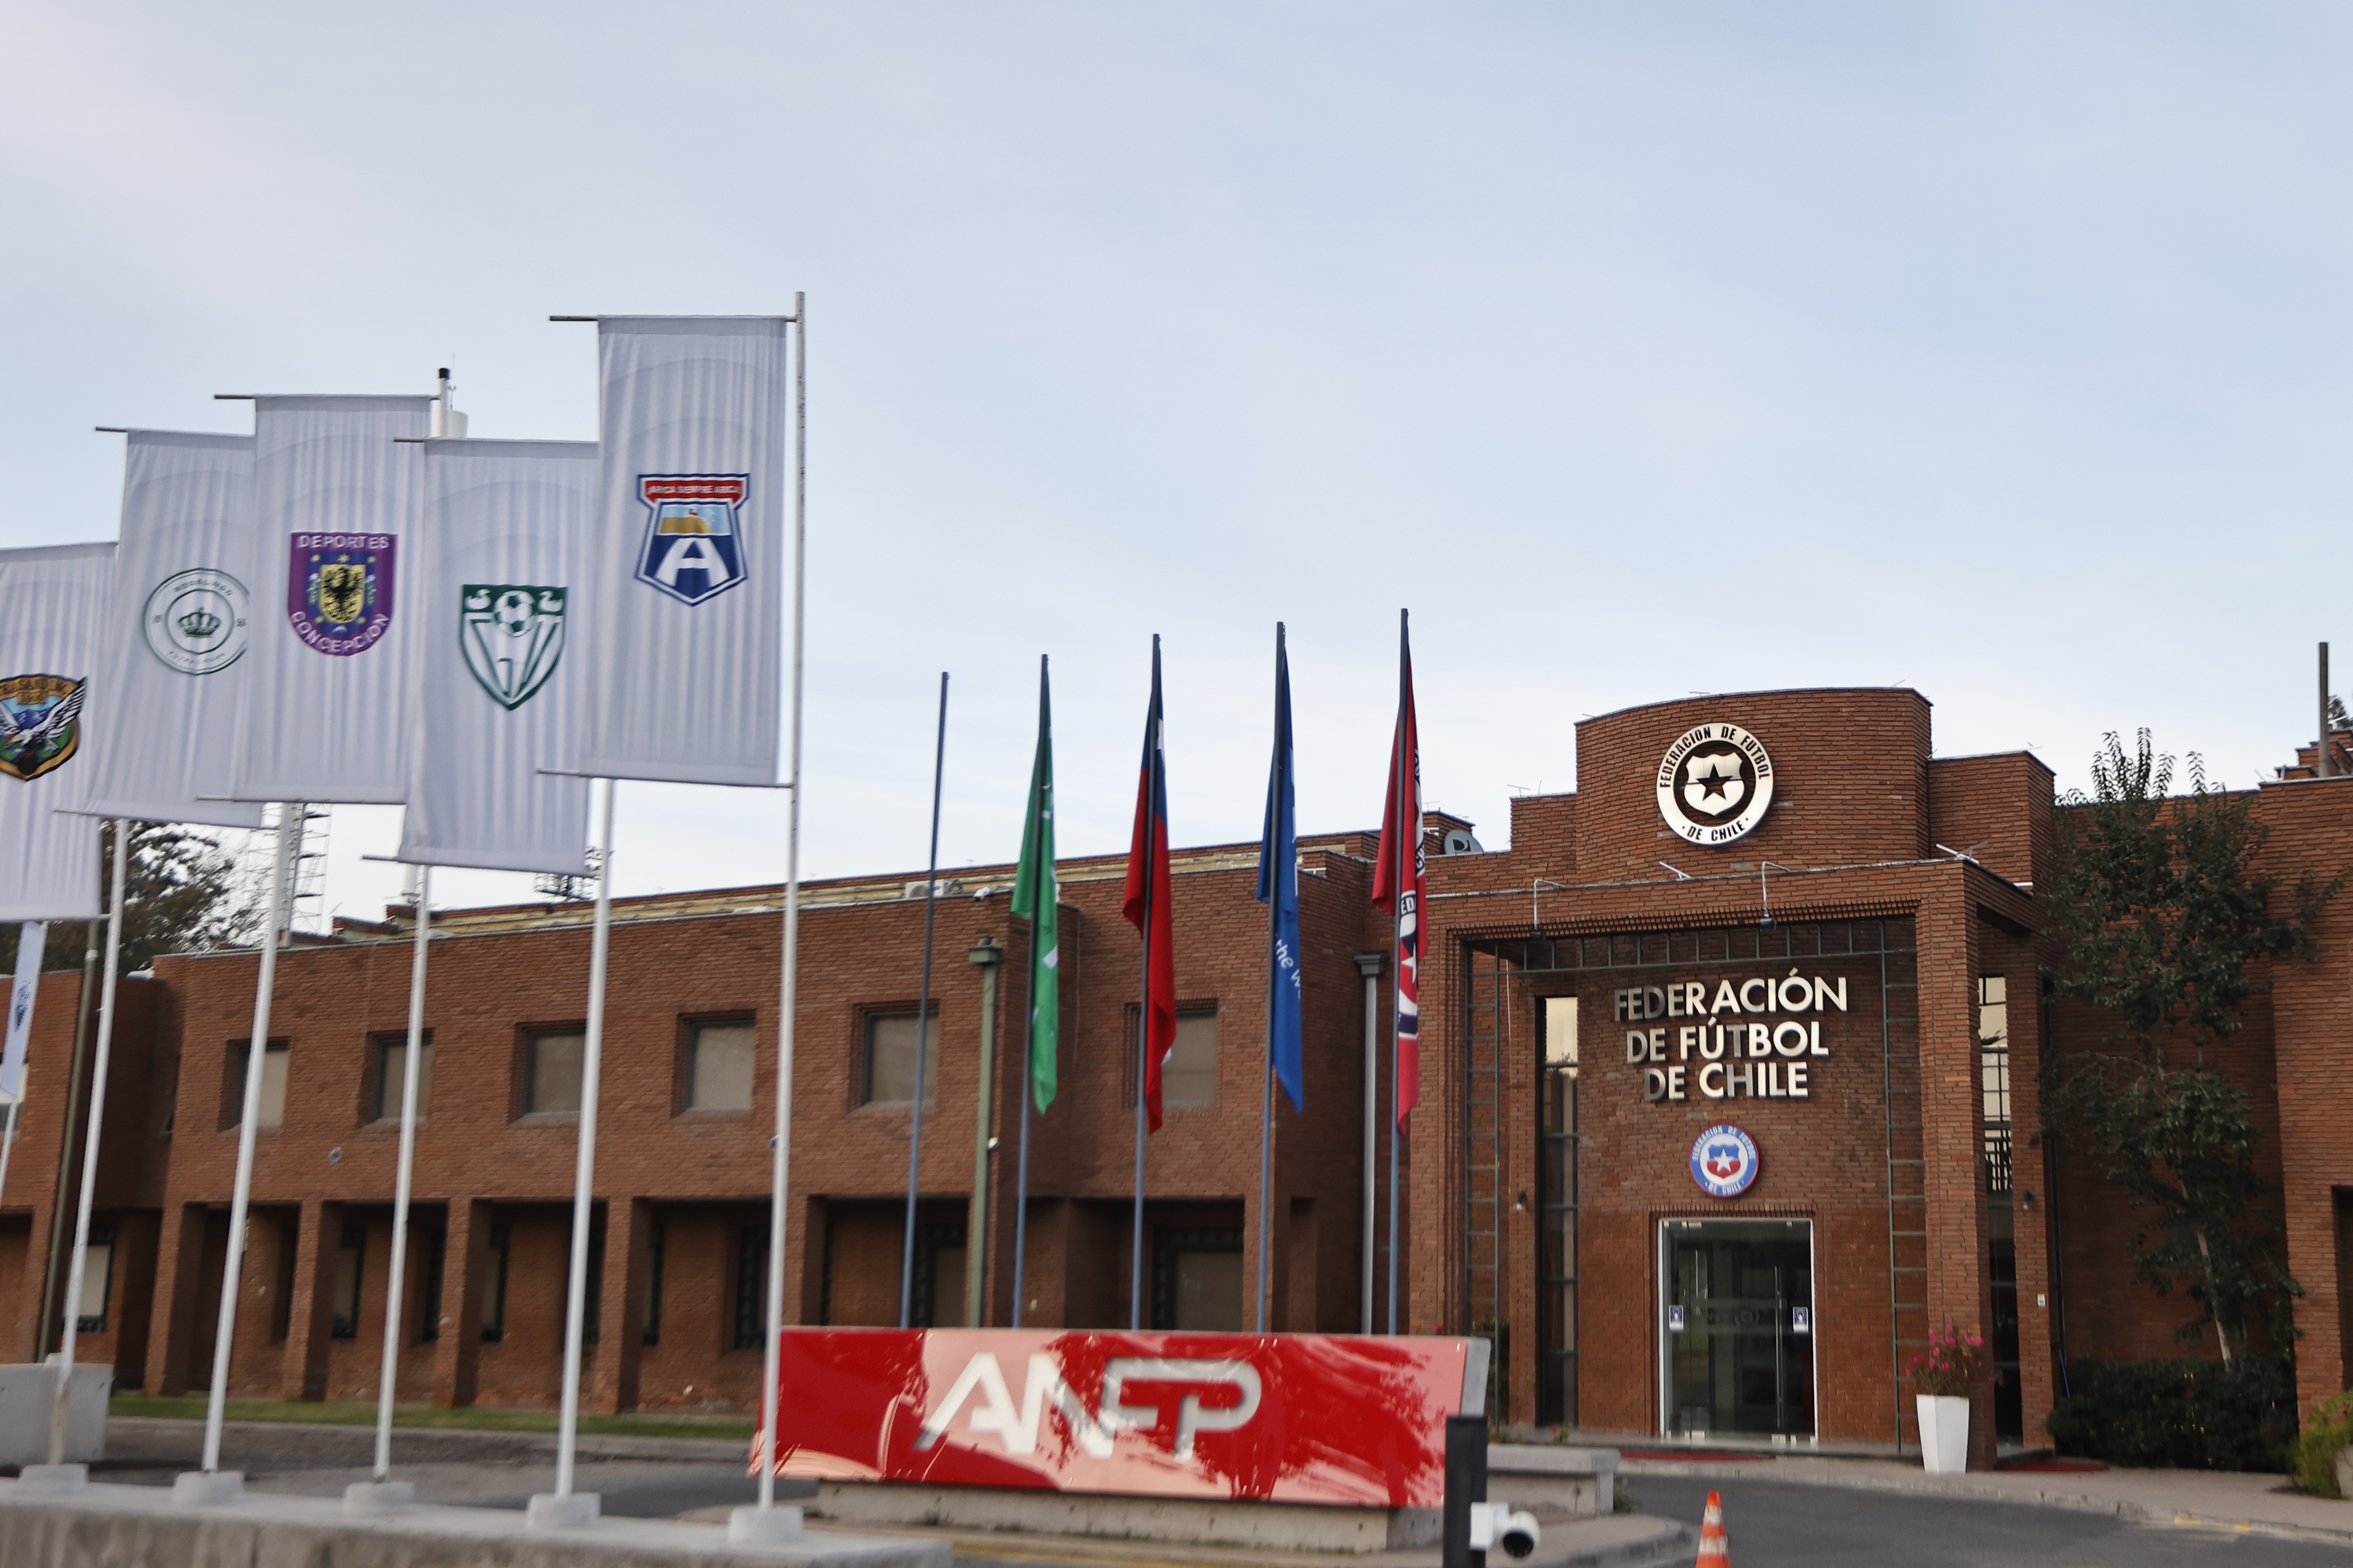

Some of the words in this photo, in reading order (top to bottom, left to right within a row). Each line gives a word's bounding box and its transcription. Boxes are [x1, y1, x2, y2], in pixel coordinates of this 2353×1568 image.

[296, 535, 390, 549] DEPORTES
[1660, 726, 1711, 788] FEDERACION
[1721, 726, 1736, 741] DE
[1740, 734, 1770, 780] FUTBOL
[1687, 825, 1703, 840] DE
[1711, 820, 1745, 841] CHILE
[1614, 967, 1848, 1022] FEDERACIÓN
[1627, 1028, 1666, 1063] DE
[1680, 1016, 1829, 1060] FÚTBOL
[1643, 1066, 1686, 1101] DE
[1699, 1061, 1808, 1099] CHILE
[1728, 1125, 1738, 1136] DE
[912, 1351, 1262, 1461] ANFP
